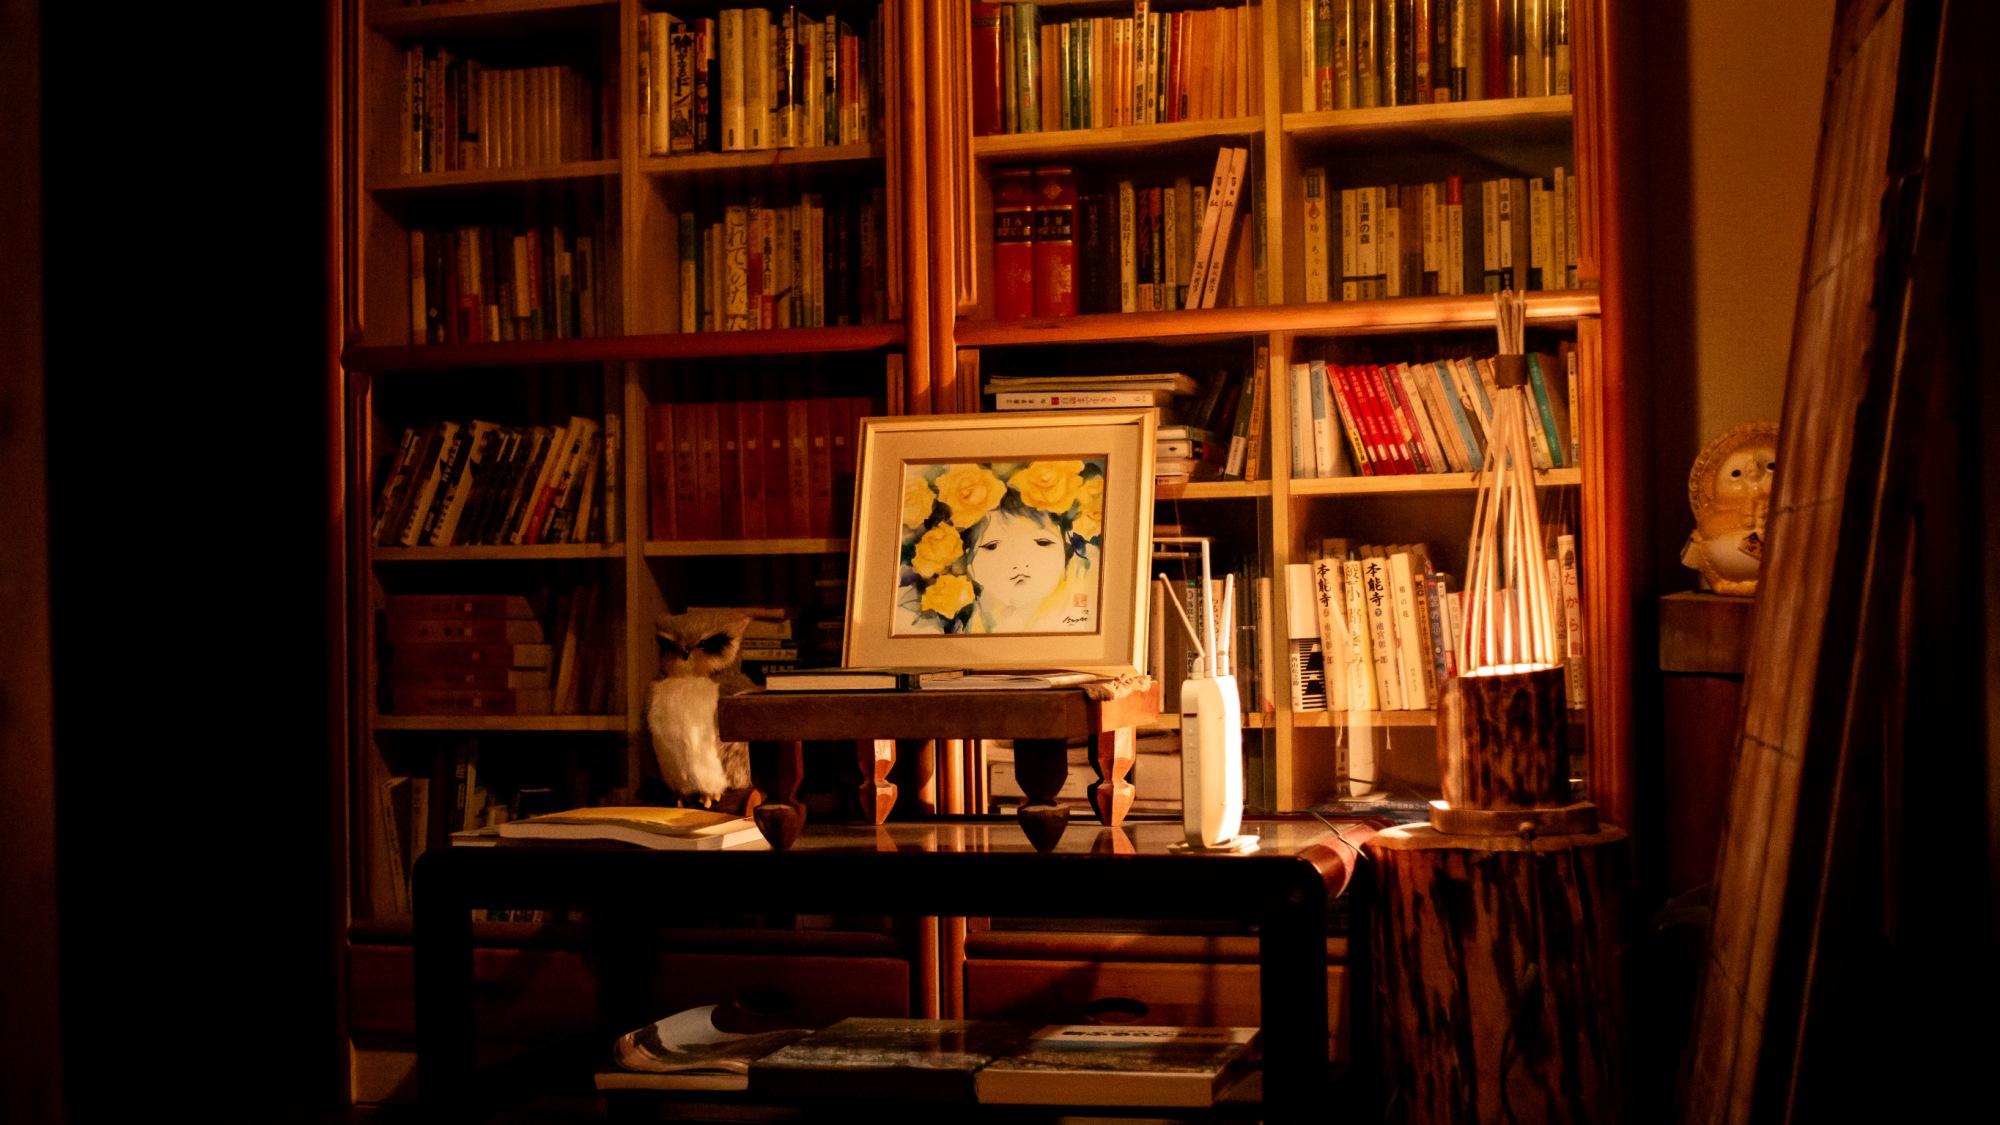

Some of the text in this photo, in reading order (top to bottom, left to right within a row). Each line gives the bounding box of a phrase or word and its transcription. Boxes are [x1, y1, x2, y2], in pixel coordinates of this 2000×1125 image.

[1359, 202, 1370, 244] 混声の森
[1309, 223, 1320, 277] 坊っちゃん
[1316, 563, 1332, 607] 本能寺
[1366, 562, 1385, 607] 本能寺
